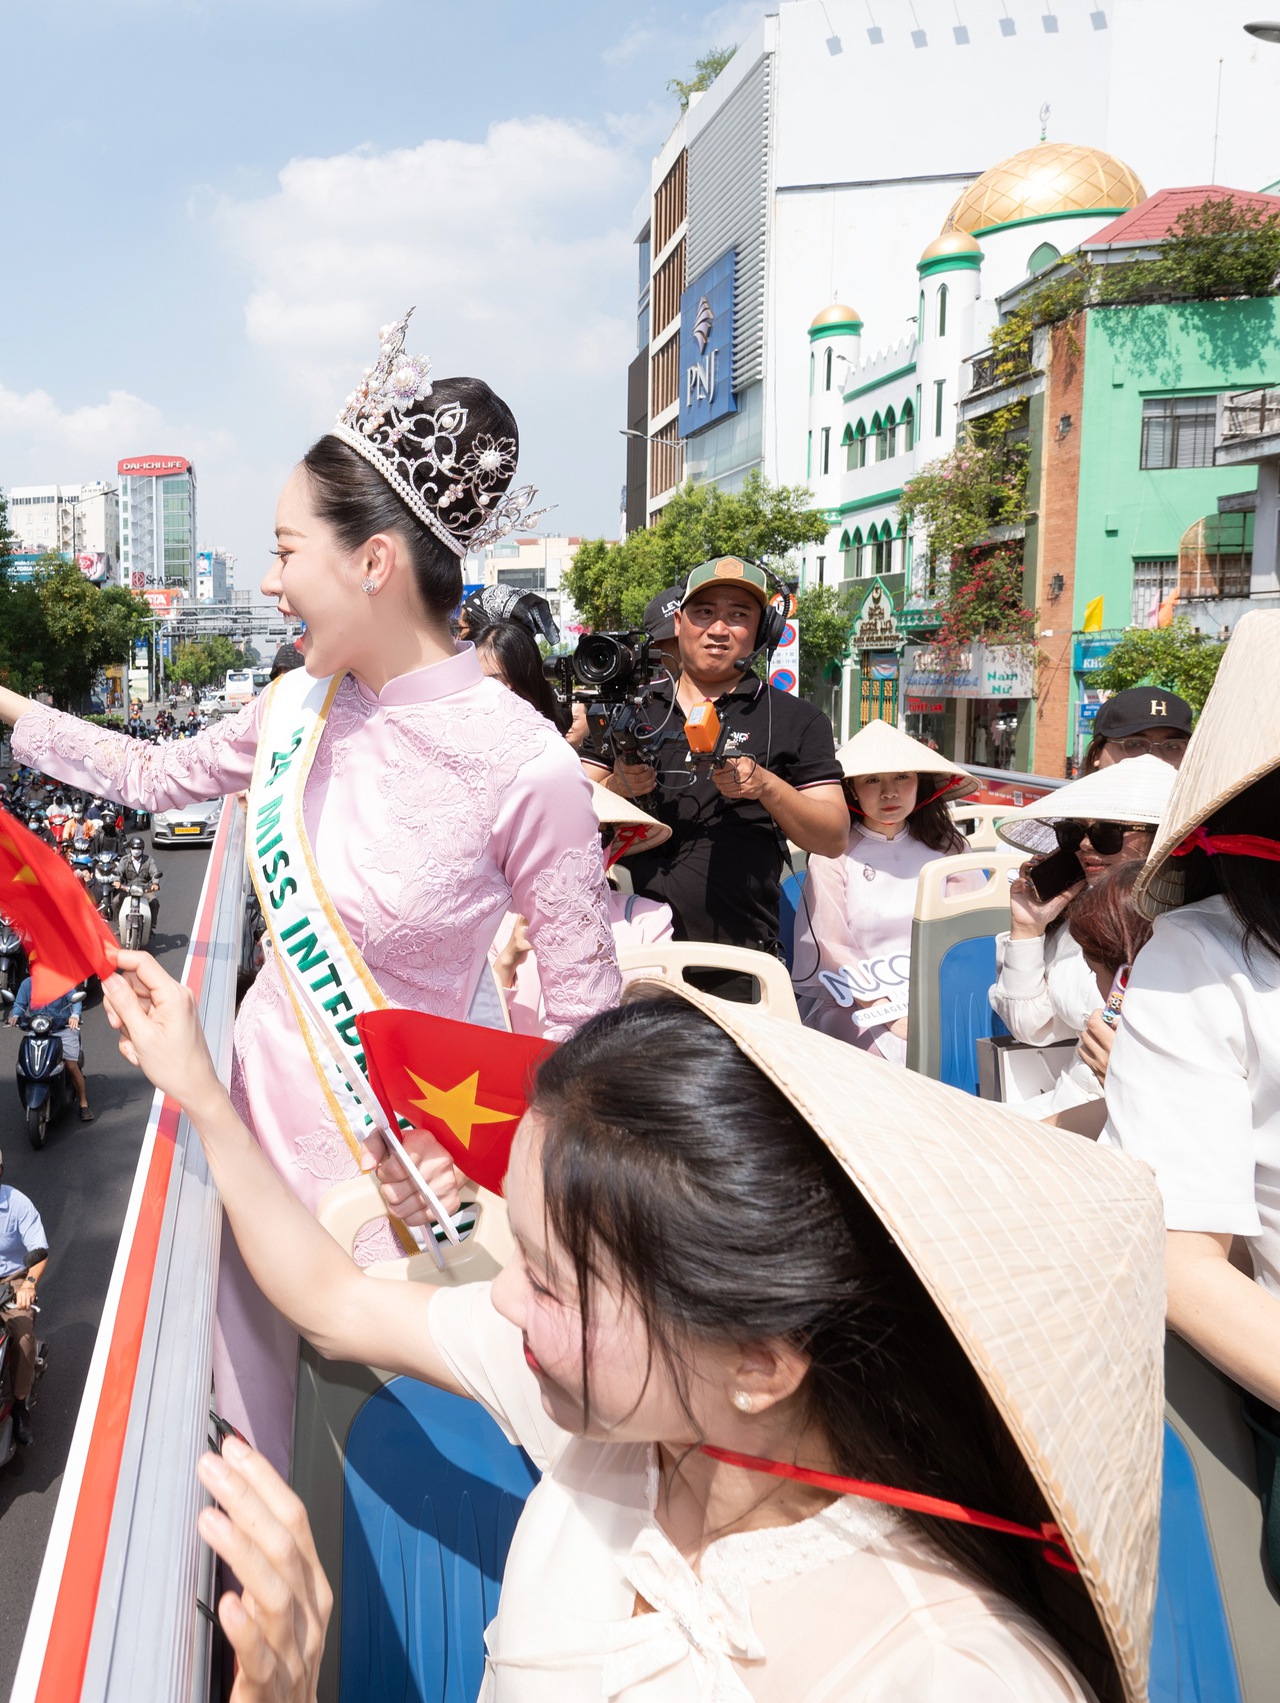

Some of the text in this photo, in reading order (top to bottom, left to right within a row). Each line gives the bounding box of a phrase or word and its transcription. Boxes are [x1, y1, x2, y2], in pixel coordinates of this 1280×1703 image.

[686, 348, 718, 407] PNJ
[123, 461, 182, 471] DAI-ICHI LIFE
[987, 671, 1018, 682] Nam
[1150, 699, 1167, 716] H
[256, 793, 298, 910] MISS
